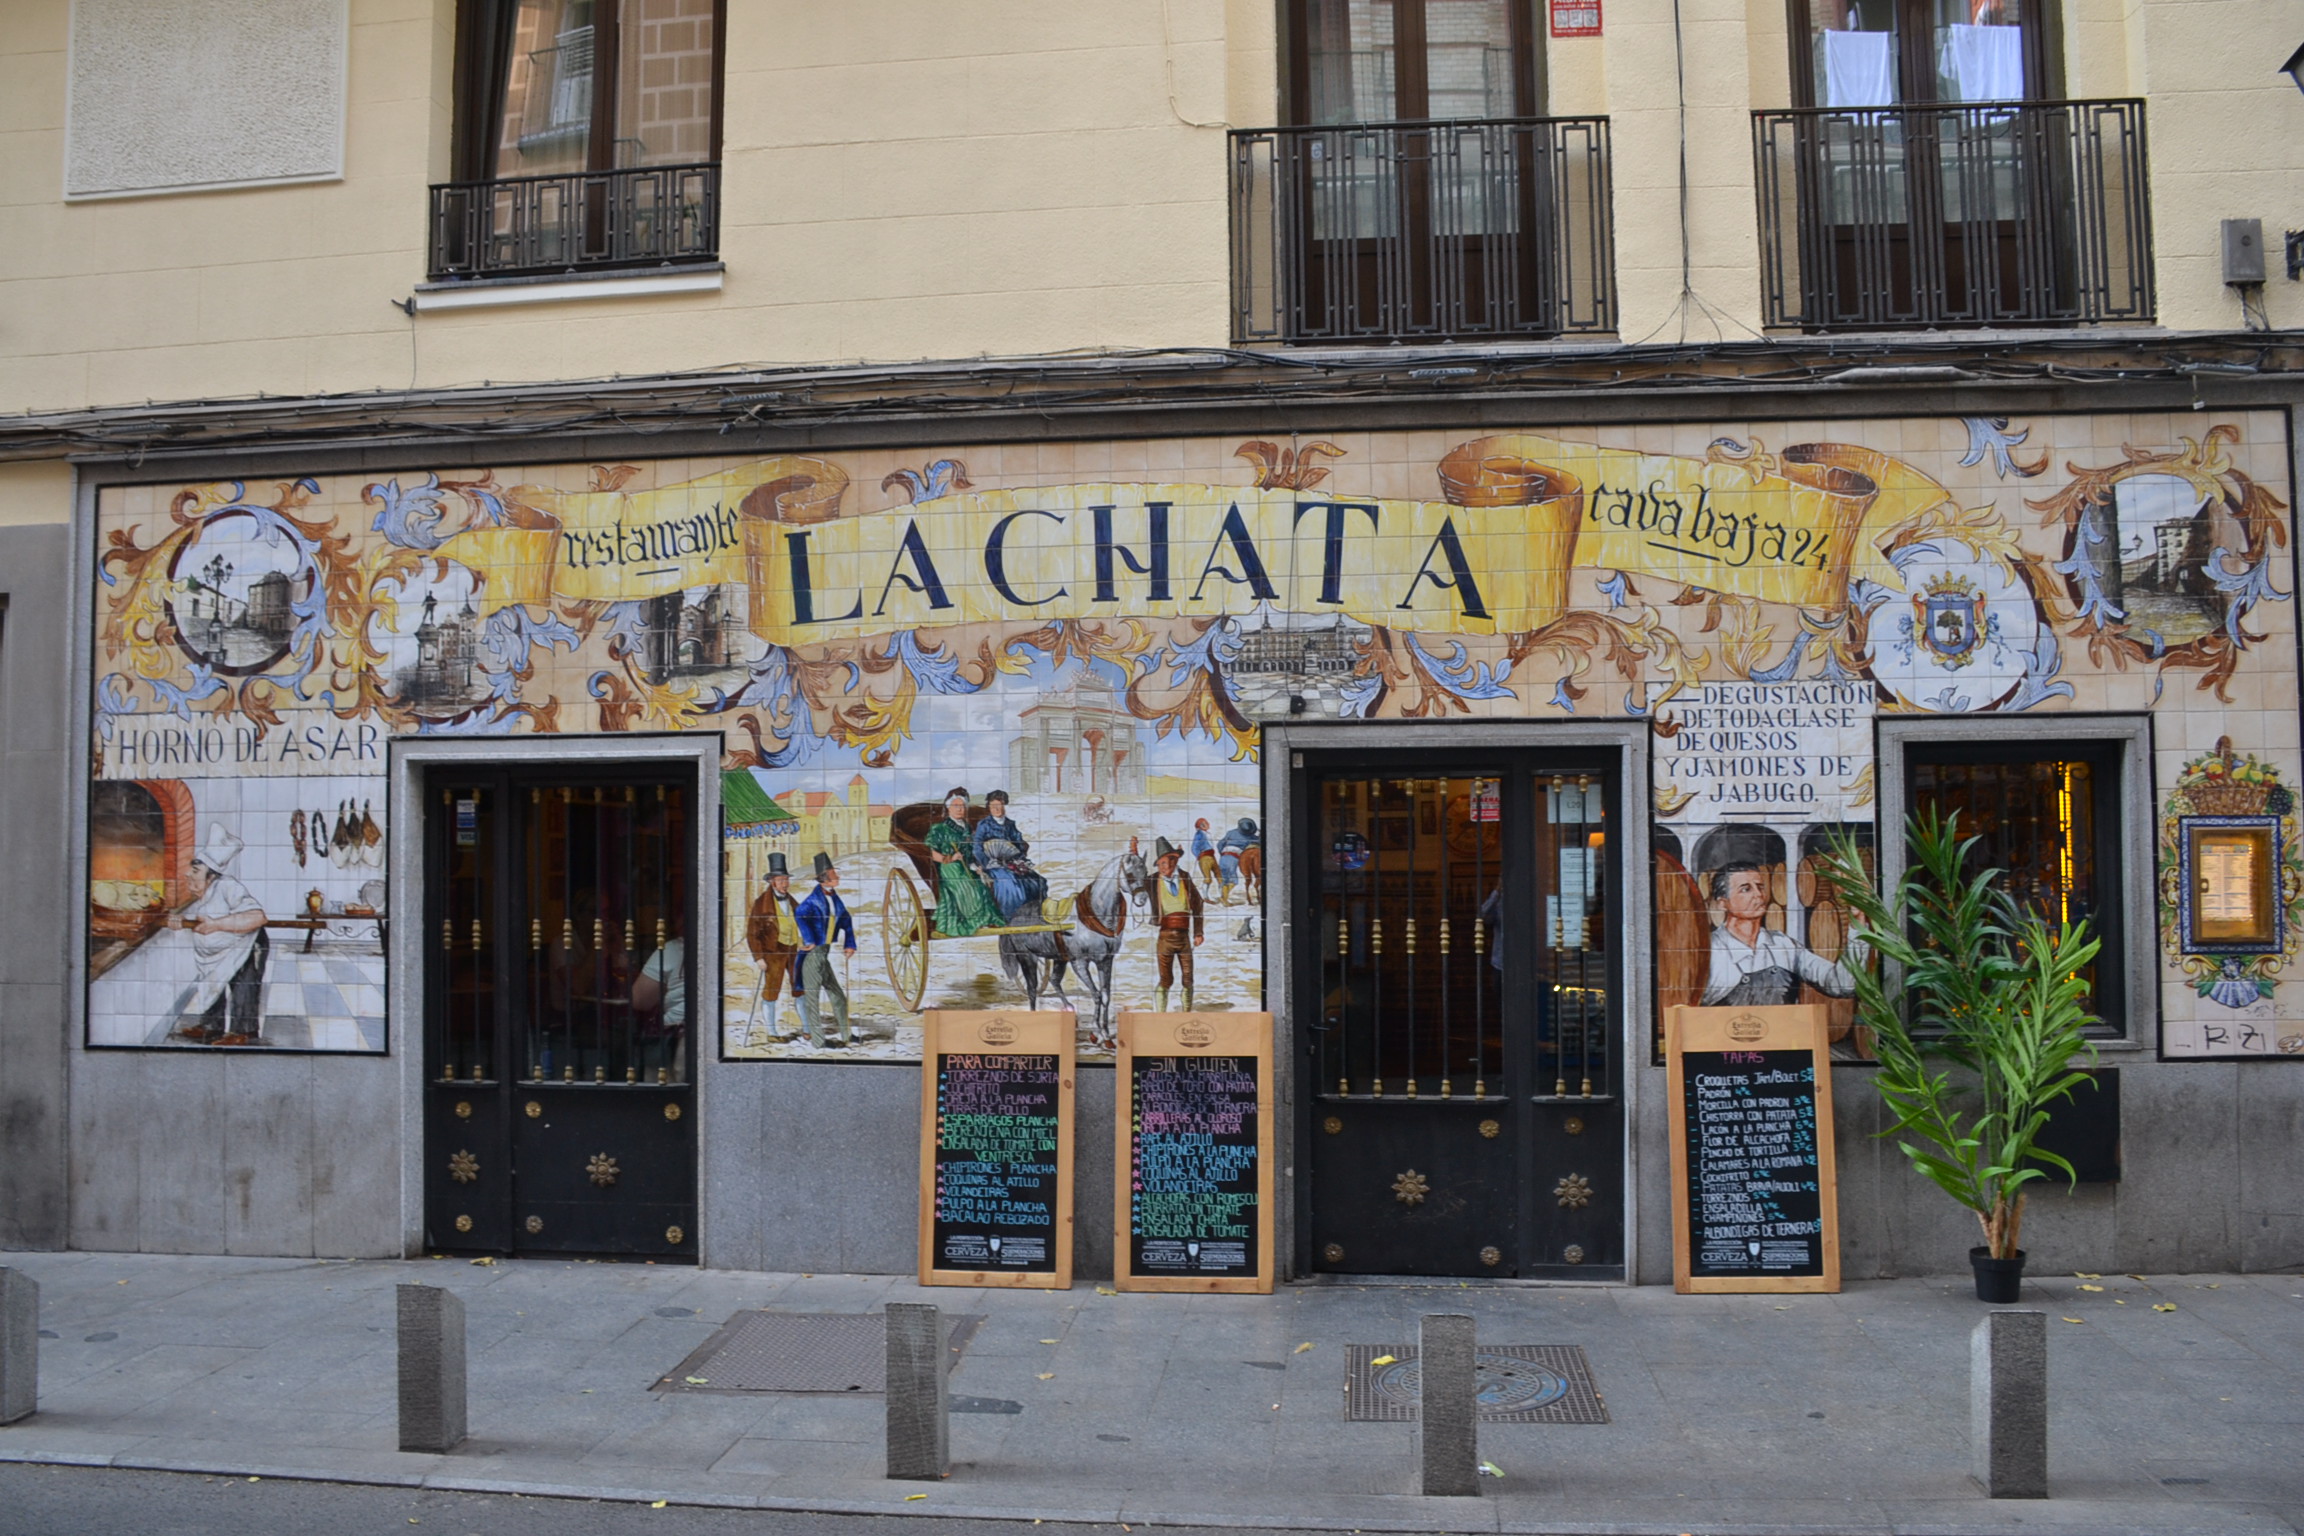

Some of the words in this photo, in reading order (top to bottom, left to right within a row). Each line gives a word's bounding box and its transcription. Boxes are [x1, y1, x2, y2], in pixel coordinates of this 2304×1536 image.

[784, 516, 955, 626] LA
[984, 500, 1493, 620] CHATA
[1703, 682, 1873, 706] DEGUSTACIÓN
[1681, 708, 1712, 729] DE
[1713, 708, 1775, 729] TODA
[1777, 708, 1856, 728] CLASE
[119, 728, 223, 765] HORNO
[235, 727, 268, 762] DE
[278, 725, 378, 762] ASAR
[1676, 732, 1706, 751] DE
[1709, 731, 1798, 752] QUESOS
[1662, 758, 1681, 777] Y
[1685, 756, 1806, 777] JAMONES
[1819, 756, 1852, 776] DE
[946, 1055, 982, 1069] PARA
[984, 1056, 1053, 1070] COMPARTIR
[1720, 1051, 1765, 1064] TAPAS
[1150, 1057, 1177, 1073] SIN
[1184, 1057, 1239, 1073] GLUTEN
[945, 1070, 1009, 1083] TORREZNOS
[1011, 1071, 1025, 1083] DE
[1167, 1081, 1179, 1092] DE
[1207, 1082, 1224, 1093] CON
[1225, 1082, 1256, 1094] PATATA
[1004, 1094, 1047, 1105] PLANCHA
[1189, 1093, 1202, 1103] EN
[1204, 1094, 1230, 1103] SALSA
[1742, 1099, 1757, 1109] CON
[981, 1105, 995, 1115] DE
[999, 1105, 1029, 1116] POLLO
[1212, 1102, 1257, 1114] TERNERA
[943, 1114, 1013, 1127] ESPARRAGOS
[1016, 1116, 1058, 1127] PLANCHA
[1194, 1113, 1205, 1123] AL
[1699, 1111, 1745, 1123] CHISTORRA
[1746, 1111, 1763, 1121] CON
[1765, 1109, 1798, 1120] PATATA
[1012, 1127, 1031, 1139] CON
[1031, 1128, 1057, 1140] MIEL
[1173, 1124, 1181, 1134] A
[1183, 1124, 1196, 1134] LA
[1199, 1123, 1242, 1134] PLANCHA
[1732, 1124, 1740, 1134] A
[1743, 1124, 1754, 1134] LA
[1756, 1121, 1792, 1133] PLANCHA
[942, 1137, 988, 1150] ENSALADA
[990, 1139, 1001, 1150] DE
[1003, 1139, 1037, 1151] TOMATE
[1038, 1139, 1056, 1151] CON
[1165, 1133, 1176, 1145] AL
[1702, 1135, 1723, 1147] FLOR
[1725, 1135, 1739, 1146] DE
[975, 1151, 1035, 1163] VENTRESCA
[1198, 1145, 1205, 1156] A
[1206, 1145, 1218, 1157] LA
[1701, 1146, 1733, 1158] PINCHO
[1734, 1146, 1746, 1156] DE
[1748, 1144, 1789, 1157] TORTILLA
[1010, 1163, 1057, 1174] PLANCHA
[1141, 1156, 1171, 1168] PULPO
[1175, 1156, 1183, 1168] A
[1186, 1156, 1200, 1168] LA
[1203, 1156, 1250, 1169] PLANCHA
[1700, 1159, 1750, 1171] CALAMARES
[1751, 1159, 1757, 1169] A
[1759, 1157, 1771, 1169] LA
[1188, 1168, 1202, 1180] AL
[991, 1176, 1005, 1187] AL
[1702, 1181, 1743, 1193] PATATAS
[1194, 1193, 1214, 1204] CON
[1701, 1192, 1751, 1203] TORREZNOS
[940, 1196, 974, 1210] PULPO
[976, 1199, 984, 1211] A
[985, 1200, 997, 1211] LA
[1001, 1200, 1048, 1213] PLANCHA
[1187, 1204, 1205, 1215] CON
[1206, 1204, 1242, 1216] TOMATE
[1702, 1203, 1763, 1215] ENSALADILLA
[940, 1210, 991, 1224] BACALAO
[1142, 1214, 1194, 1226] ENSALADA
[1198, 1214, 1229, 1225] CHATA
[1142, 1225, 1193, 1238] ENSALADA
[1196, 1226, 1208, 1238] DE
[1212, 1225, 1250, 1238] TOMATE
[1762, 1225, 1775, 1237] DE
[1775, 1221, 1815, 1236] TERNERA
[944, 1247, 989, 1257] CERVEZA
[1141, 1252, 1187, 1262] CERVEZA
[1700, 1252, 1748, 1262] CERVEZA
